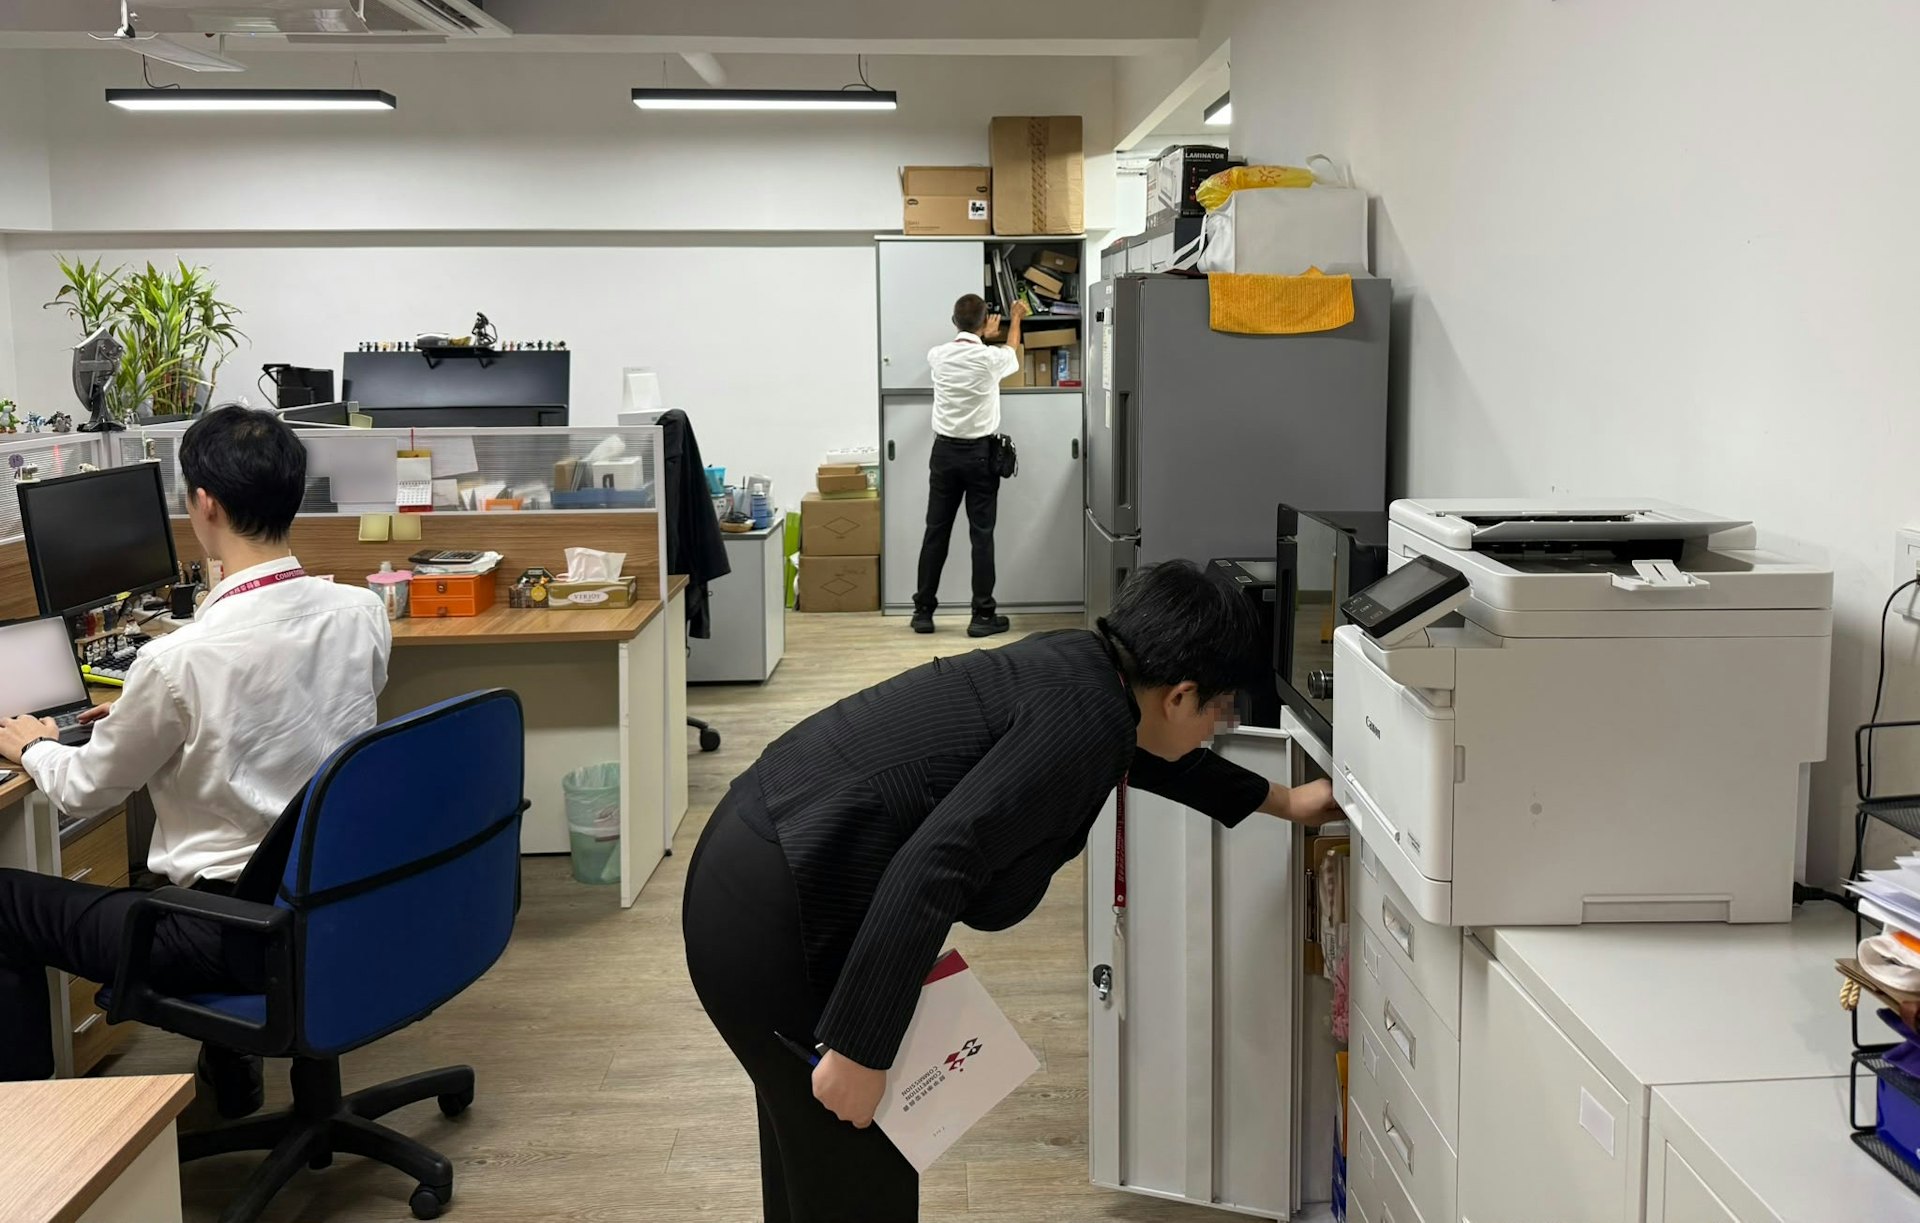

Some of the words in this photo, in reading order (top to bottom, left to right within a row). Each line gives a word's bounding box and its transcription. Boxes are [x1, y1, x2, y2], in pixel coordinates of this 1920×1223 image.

[1185, 152, 1225, 160] LAMINATOR
[1365, 715, 1381, 740] Canon
[901, 1066, 938, 1097] COMMISSION
[905, 1070, 942, 1101] COMPETITION
